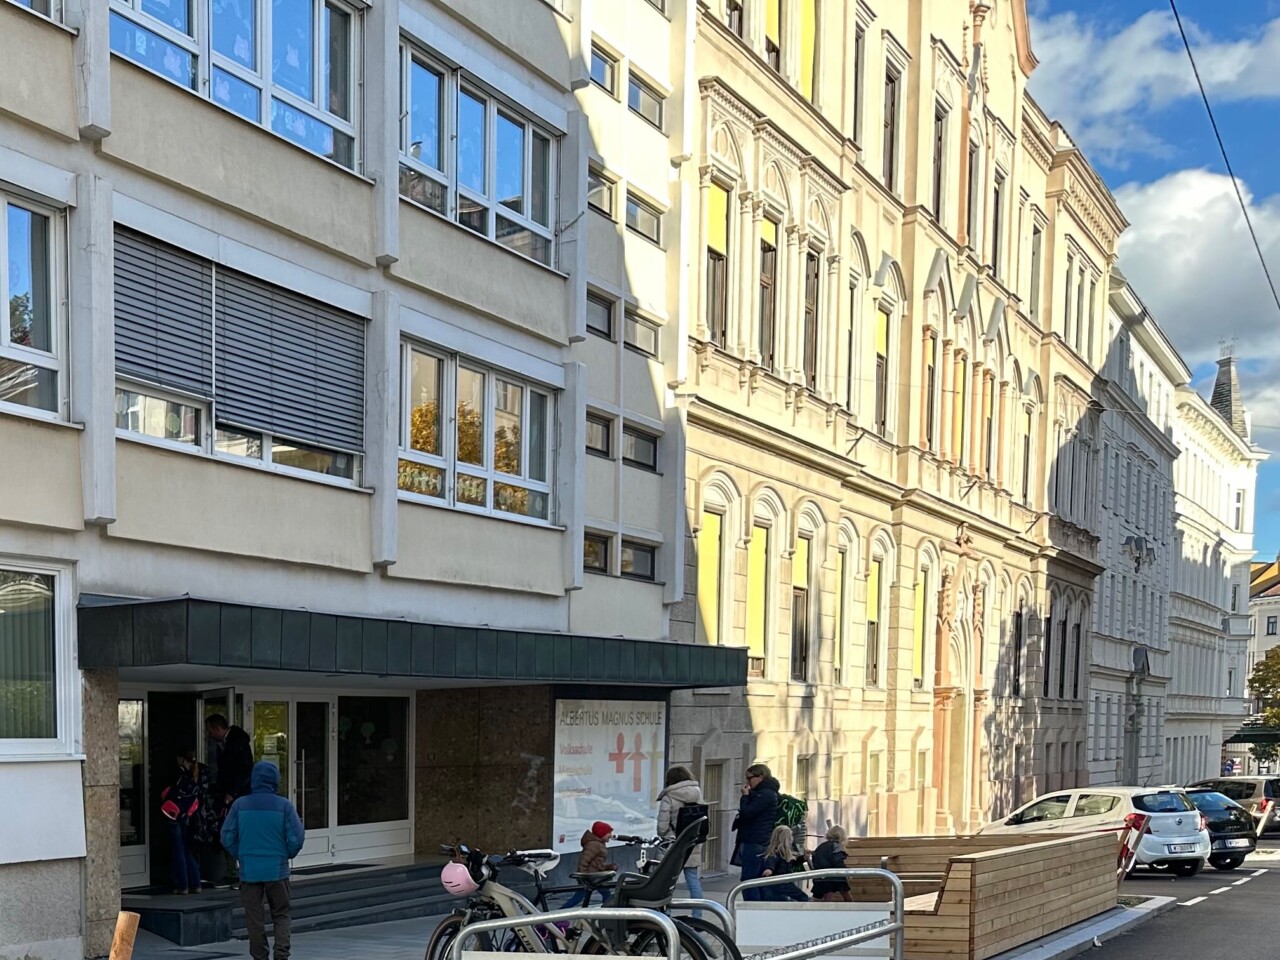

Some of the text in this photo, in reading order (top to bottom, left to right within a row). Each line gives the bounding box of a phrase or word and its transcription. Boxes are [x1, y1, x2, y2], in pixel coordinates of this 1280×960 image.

[560, 711, 662, 726] ALBERTUS MAGNUS SCHULE
